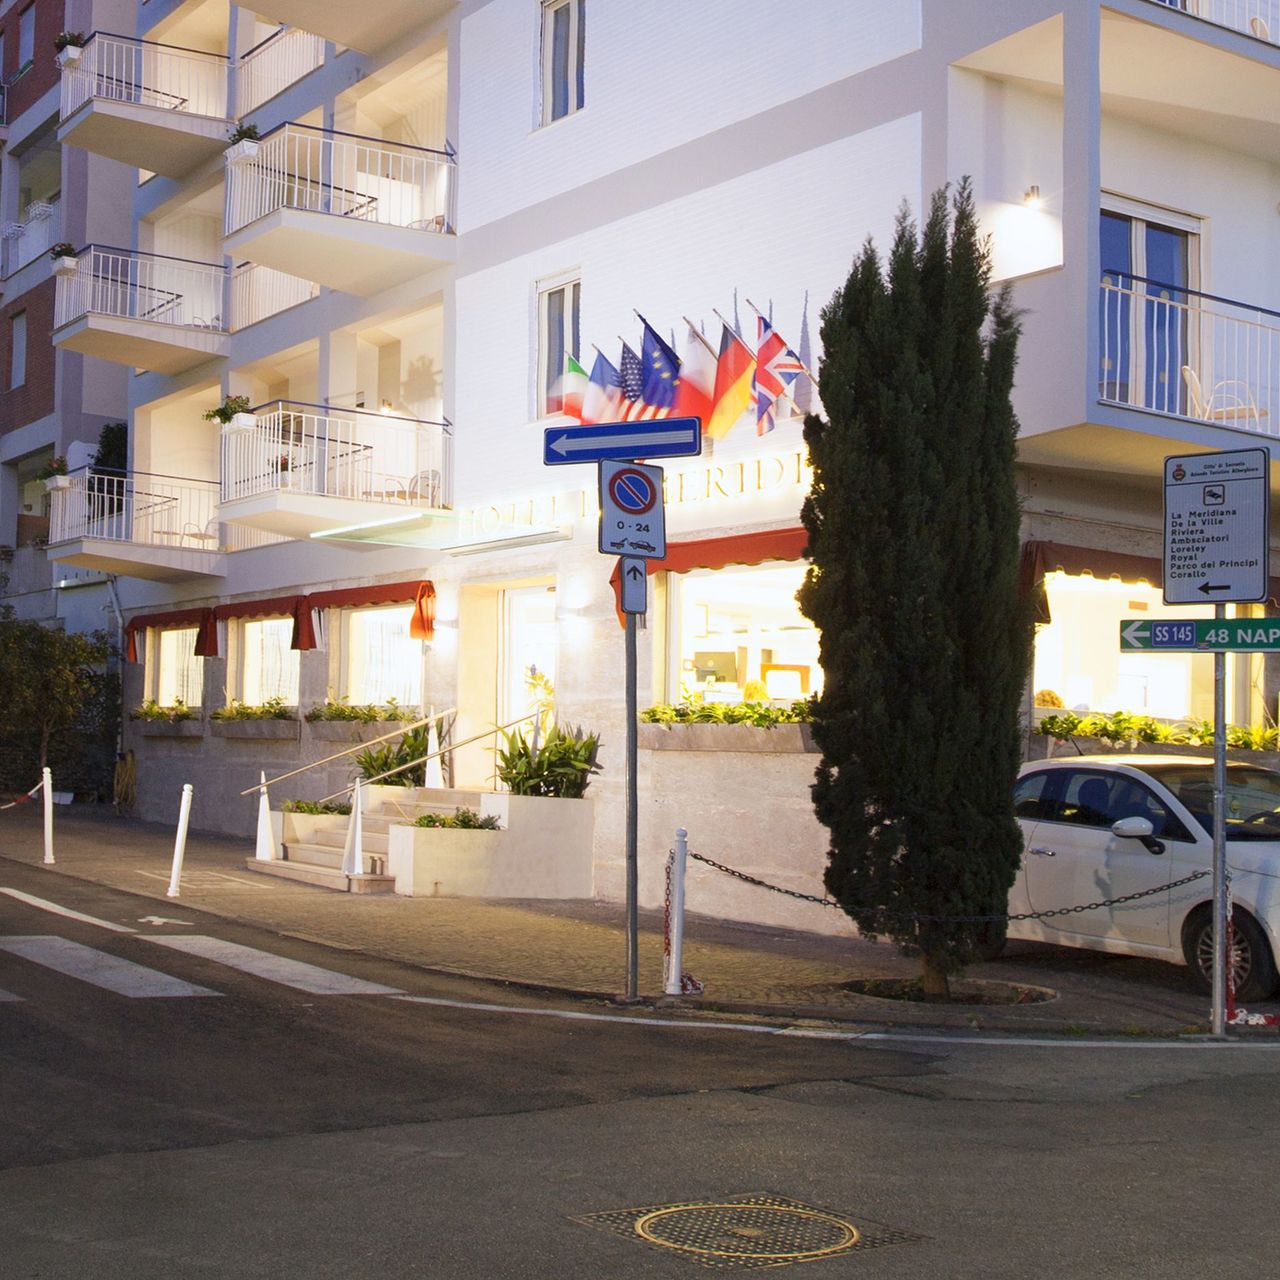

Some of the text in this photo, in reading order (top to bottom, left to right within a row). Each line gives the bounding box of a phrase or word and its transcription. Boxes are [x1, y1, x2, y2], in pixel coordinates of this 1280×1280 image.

[662, 452, 803, 505] ERIDI
[1189, 510, 1237, 519] Meridiana
[1201, 518, 1223, 526] Ville
[635, 523, 650, 533] 24
[1171, 528, 1205, 536] Riviera
[1171, 545, 1206, 553] Loreley
[1170, 553, 1198, 562] Royal
[1170, 562, 1198, 570] Parco
[1219, 559, 1258, 568] Principi
[1170, 570, 1207, 579] Corallo
[1155, 626, 1192, 641] SS 145
[1205, 629, 1229, 643] 48
